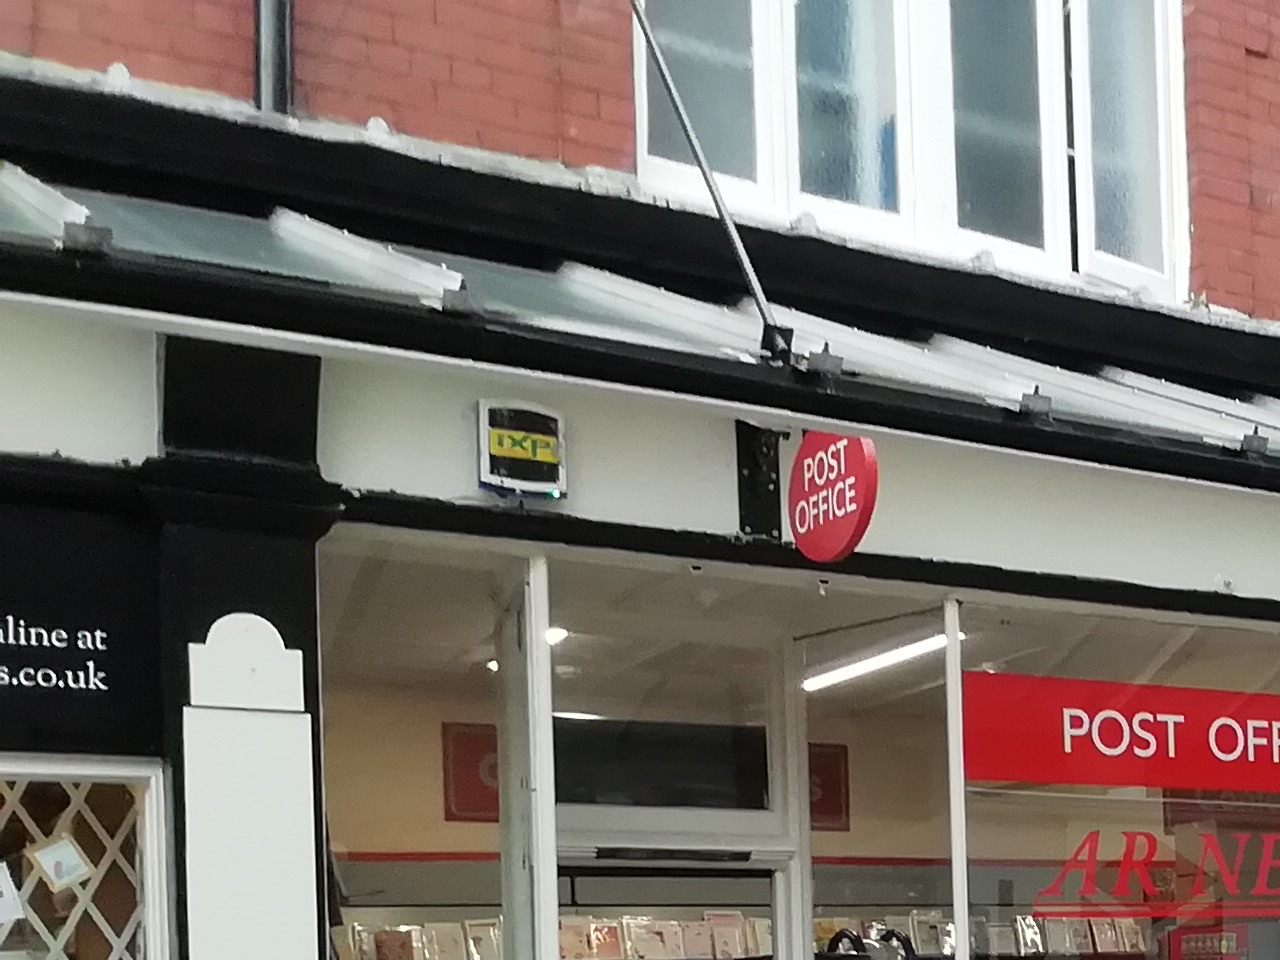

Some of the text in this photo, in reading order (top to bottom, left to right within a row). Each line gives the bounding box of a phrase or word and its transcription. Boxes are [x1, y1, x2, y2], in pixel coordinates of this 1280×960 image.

[803, 438, 849, 492] POST
[795, 475, 858, 535] OFFICE
[76, 628, 108, 650] at
[1062, 707, 1185, 758] POST
[1035, 829, 1160, 897] AR
